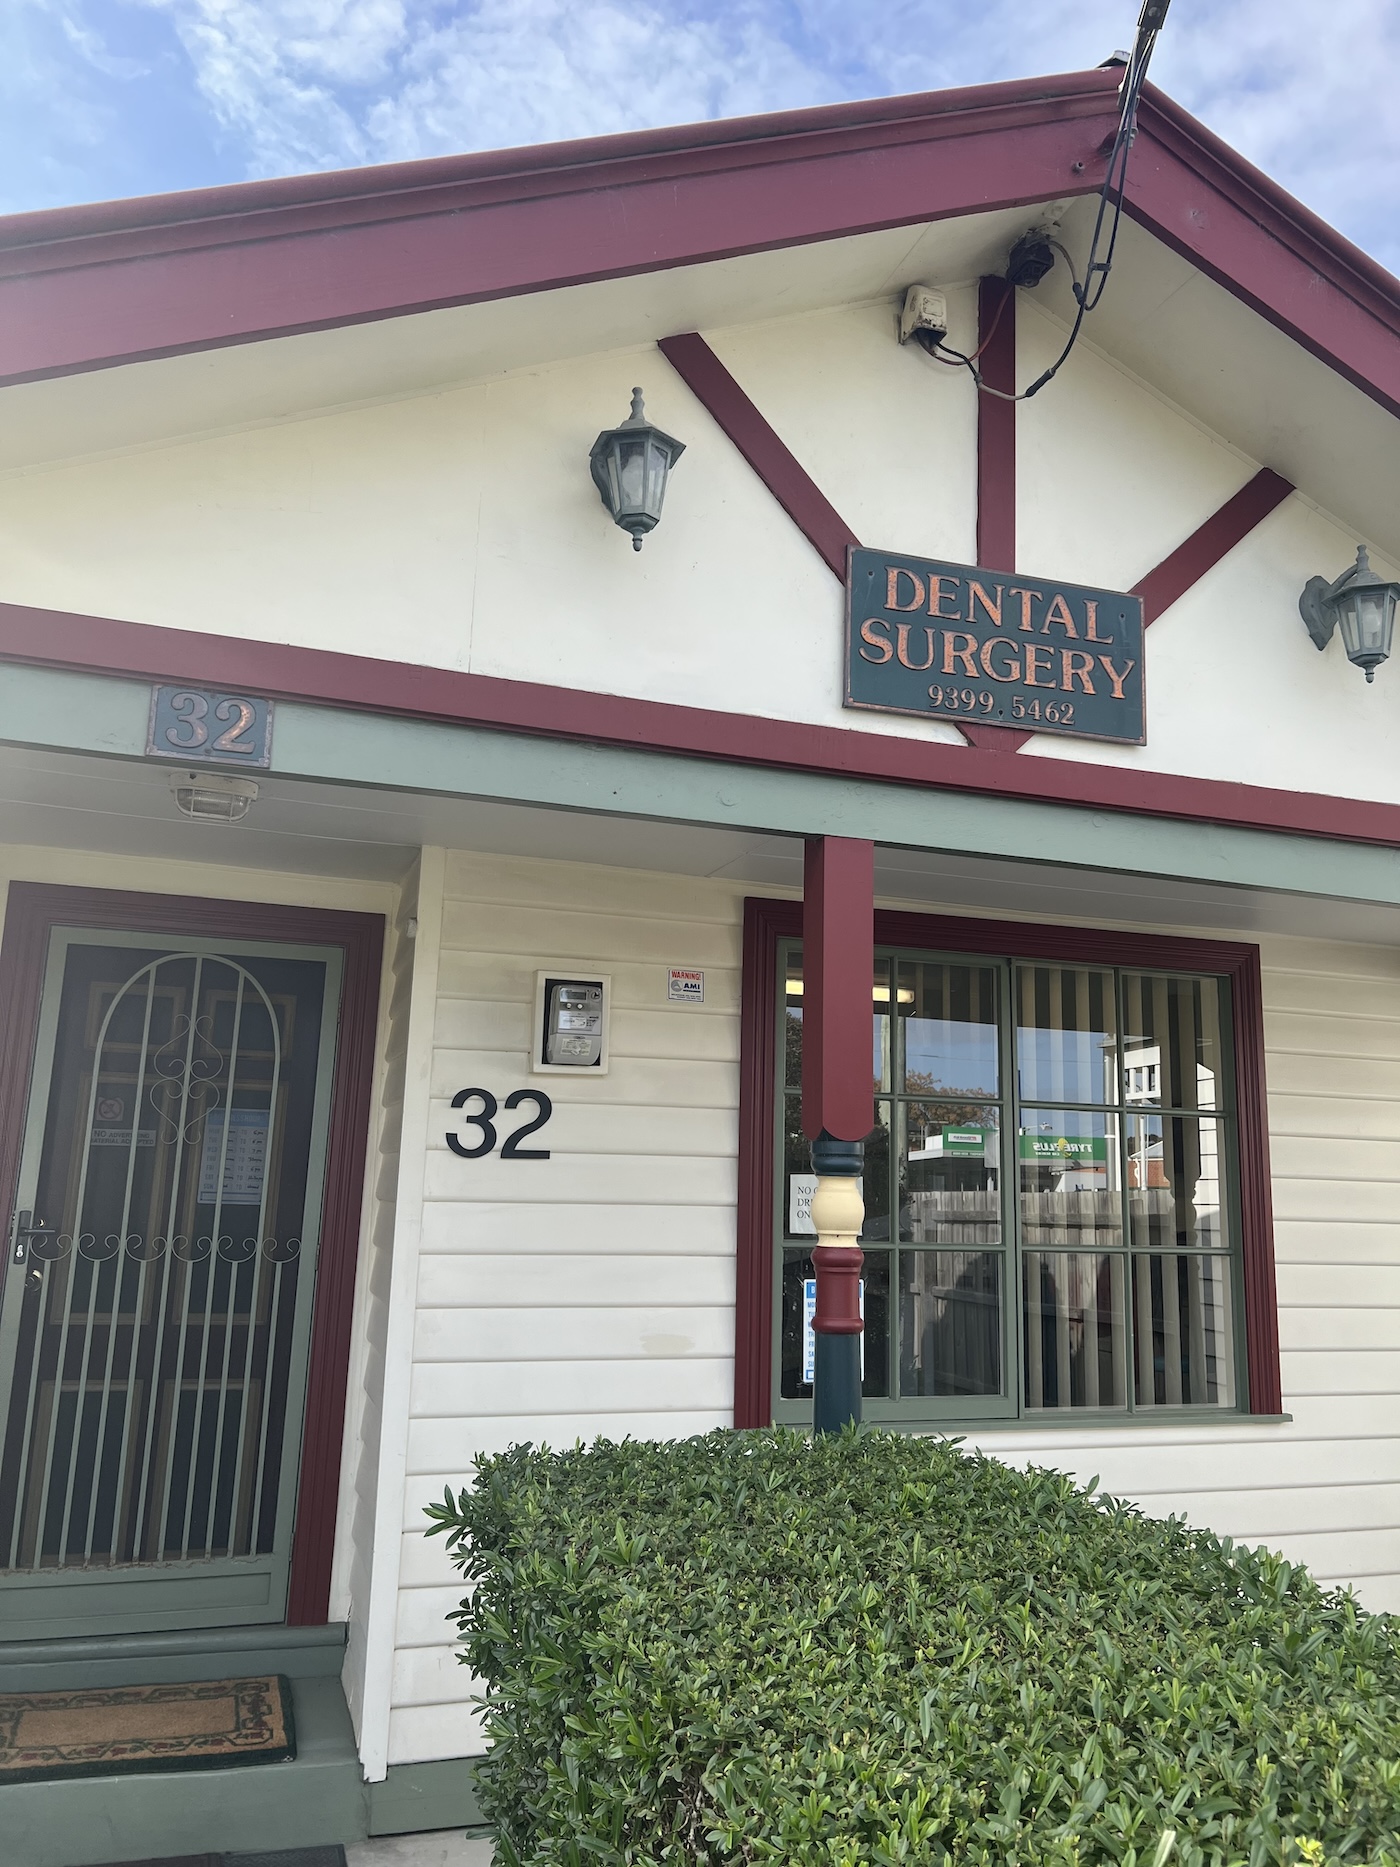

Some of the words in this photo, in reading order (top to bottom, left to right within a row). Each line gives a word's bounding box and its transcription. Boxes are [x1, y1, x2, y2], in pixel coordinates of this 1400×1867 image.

[882, 565, 1114, 645] DENTAL
[858, 617, 1136, 699] SURGERY
[165, 691, 257, 754] 32
[927, 684, 995, 715] 9399
[1011, 695, 1076, 726] 5462
[445, 1087, 553, 1160] 32
[797, 1186, 812, 1194] NO
